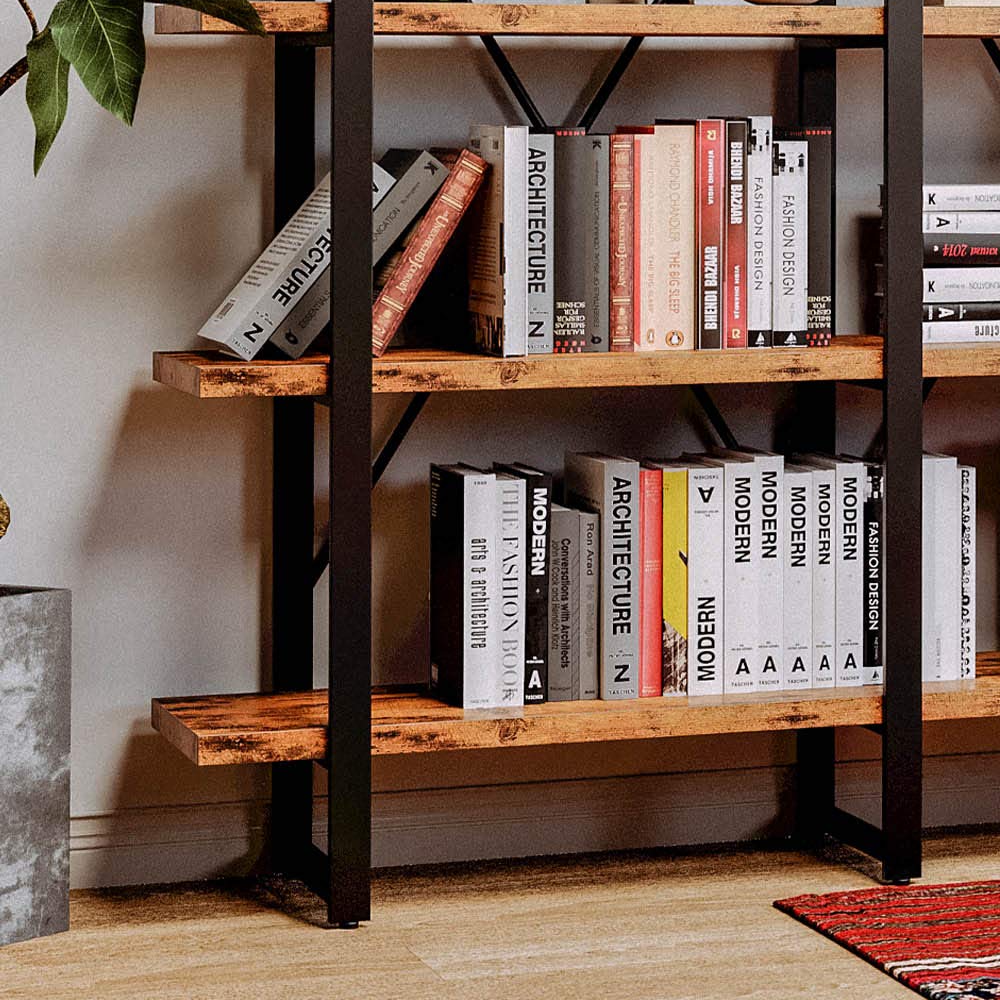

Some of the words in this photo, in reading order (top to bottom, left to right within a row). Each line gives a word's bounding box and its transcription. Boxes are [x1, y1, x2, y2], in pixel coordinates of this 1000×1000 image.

[730, 141, 743, 181] BHENDI
[527, 148, 547, 294] ARCHITECTURE
[730, 184, 743, 225] BAZAAR
[754, 176, 764, 235] FASHION
[782, 195, 795, 247] FASHION
[754, 241, 764, 291] DESIGN
[782, 251, 795, 296] DESIGN
[942, 243, 967, 257] 2014
[502, 483, 519, 531] THE
[531, 488, 547, 576] MODERN
[735, 477, 750, 563] MODERN
[762, 471, 777, 558] MODERN
[791, 486, 806, 567] MODERN
[818, 484, 830, 565] MODERN
[843, 477, 857, 560] MODERN
[470, 539, 487, 561] arts
[586, 523, 594, 546] Ron
[612, 476, 632, 636] ARCHITECTURE
[868, 521, 879, 578] FASHION
[502, 536, 519, 632] FASHION
[586, 548, 594, 576] Arad
[470, 580, 489, 649] architecture
[868, 583, 879, 630] DESIGN
[502, 639, 519, 687] BOOK
[697, 596, 715, 681] MODERN
[614, 664, 631, 683] N
[735, 659, 750, 675] A
